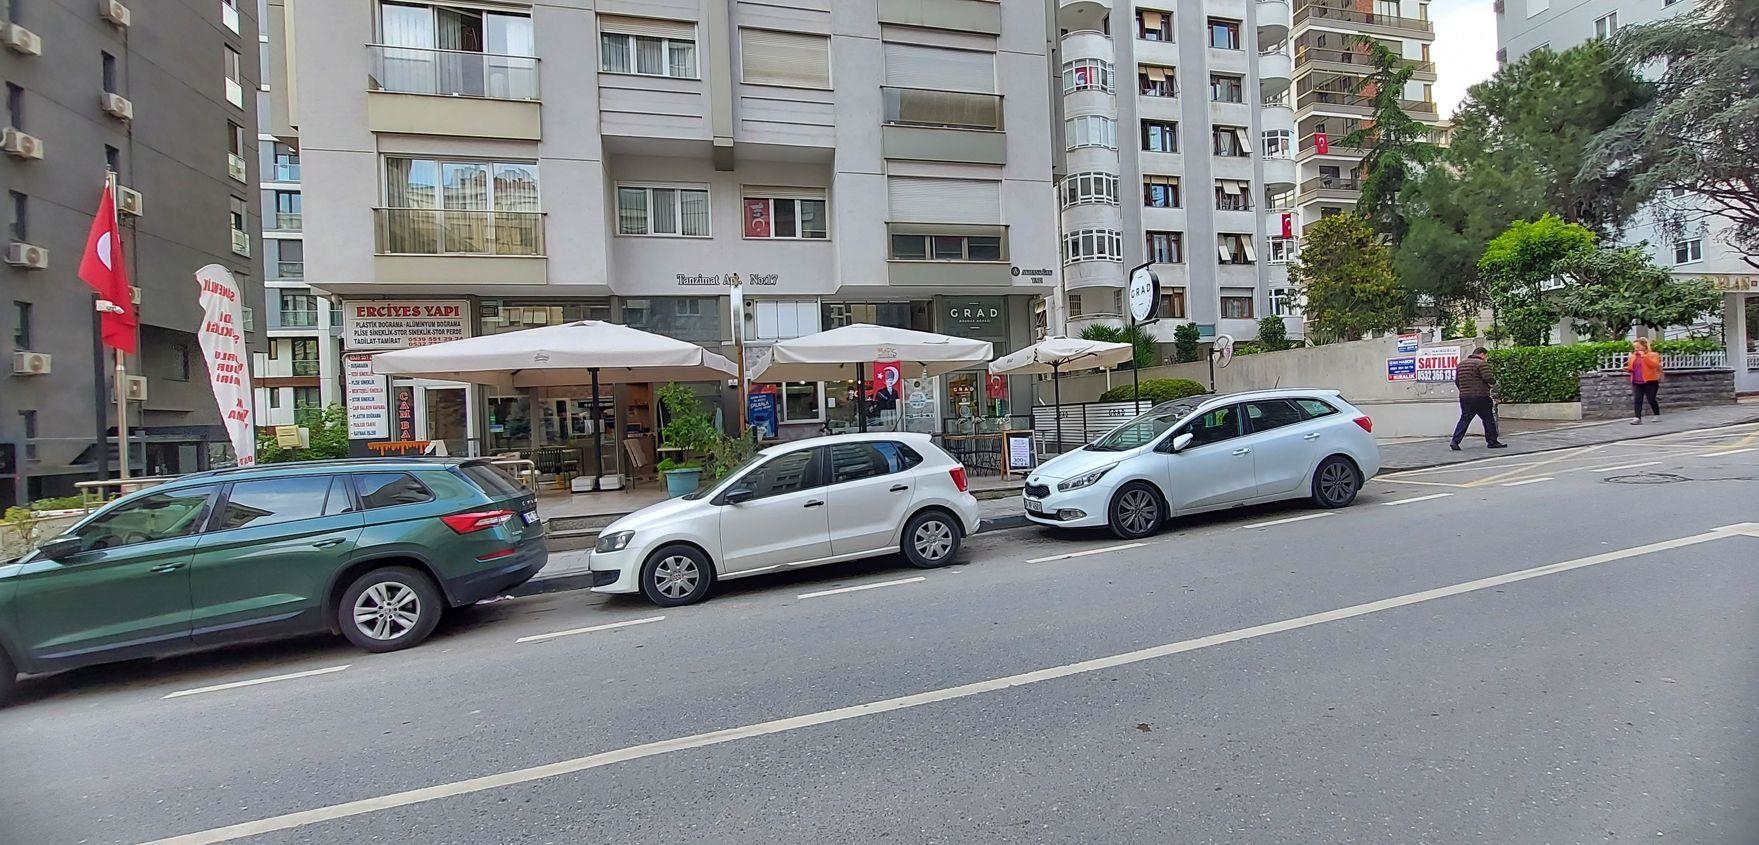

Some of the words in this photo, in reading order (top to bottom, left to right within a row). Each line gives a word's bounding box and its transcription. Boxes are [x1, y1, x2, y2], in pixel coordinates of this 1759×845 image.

[676, 273, 720, 286] Tanzimat
[1131, 283, 1151, 299] GRAD
[356, 303, 421, 318] ERCİYES
[424, 305, 460, 317] YAPI
[950, 308, 998, 318] GRAD
[356, 321, 377, 329] PLASTİK
[437, 320, 461, 328] DOĞRAMA
[354, 328, 370, 337] PLİSE
[1418, 356, 1458, 369] SATILIK
